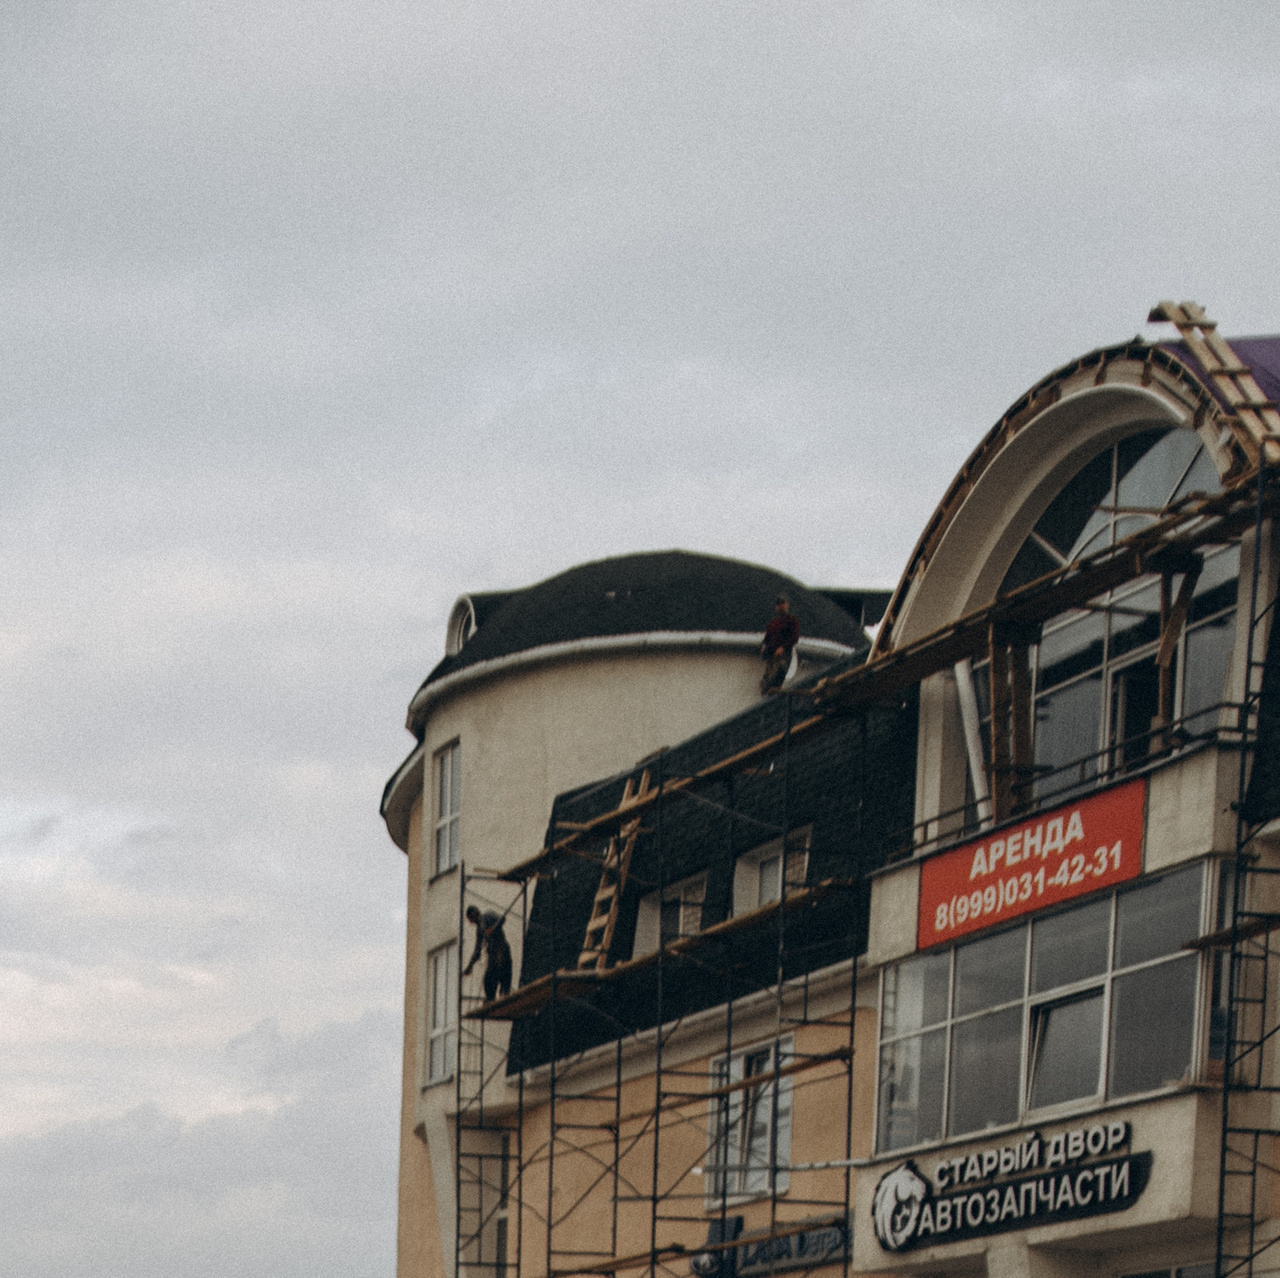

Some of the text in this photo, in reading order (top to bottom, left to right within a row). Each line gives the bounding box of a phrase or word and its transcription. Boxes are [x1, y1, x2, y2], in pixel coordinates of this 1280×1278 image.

[969, 810, 1085, 881] АРЕНДА
[934, 840, 1123, 931] 8(999)031-42-31
[933, 1120, 1128, 1188] СТАРЫЙ ДВОР
[917, 1160, 1130, 1236] АВТОЗАПЧАСТИ
